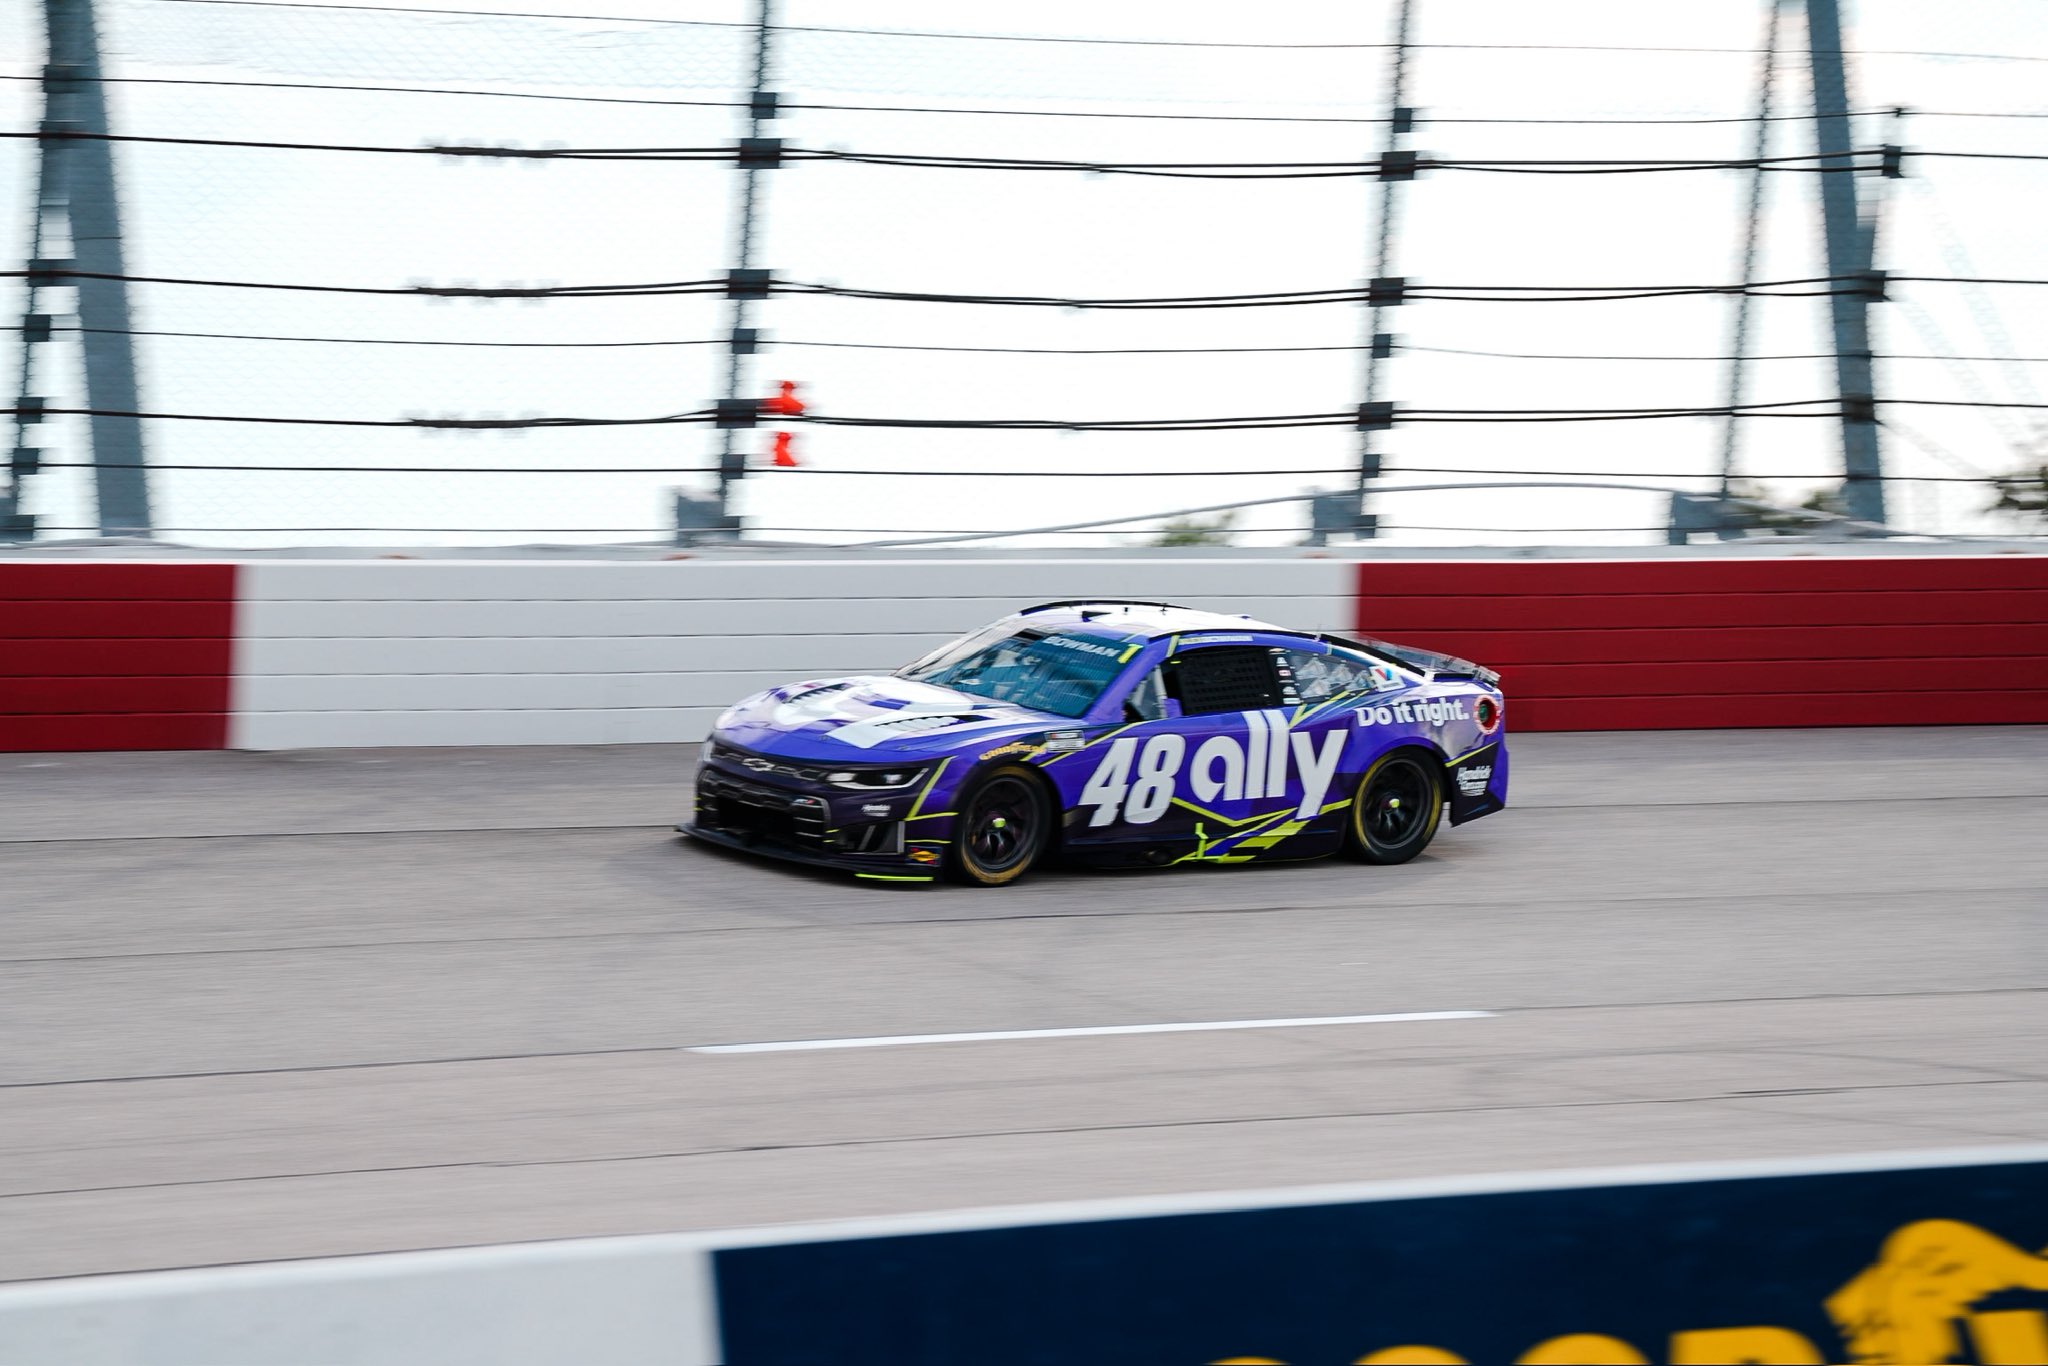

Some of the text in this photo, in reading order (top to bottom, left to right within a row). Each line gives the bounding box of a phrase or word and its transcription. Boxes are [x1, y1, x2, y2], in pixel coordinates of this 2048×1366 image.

[1042, 635, 1120, 657] BOWMAN
[1355, 697, 1470, 727] Do it right.
[1078, 709, 1349, 827] 48 ally
